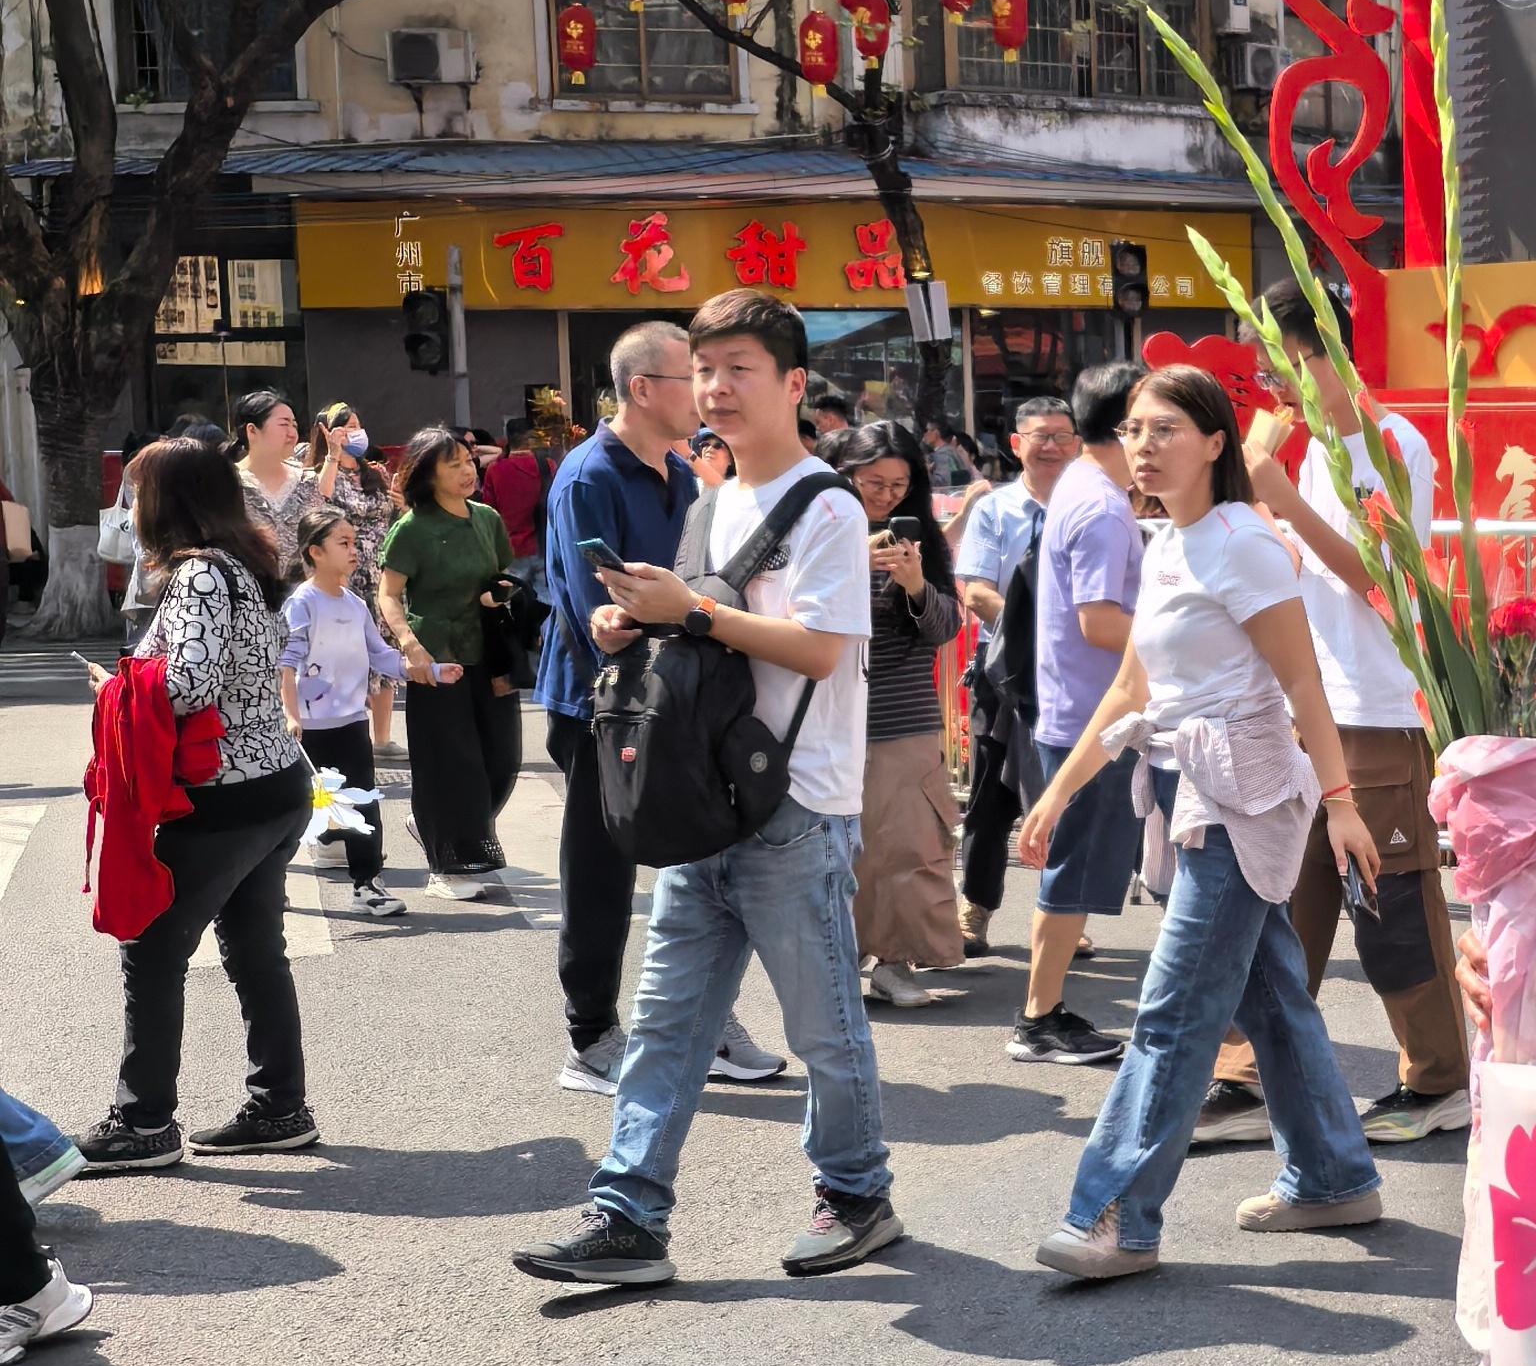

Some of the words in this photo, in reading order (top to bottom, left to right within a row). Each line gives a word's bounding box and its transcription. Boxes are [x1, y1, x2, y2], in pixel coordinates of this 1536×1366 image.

[394, 211, 424, 295] 广州市
[492, 210, 907, 295] 百花甜品
[1046, 236, 1135, 267] 旗舰
[981, 271, 1195, 297] 餐饮管理有公司
